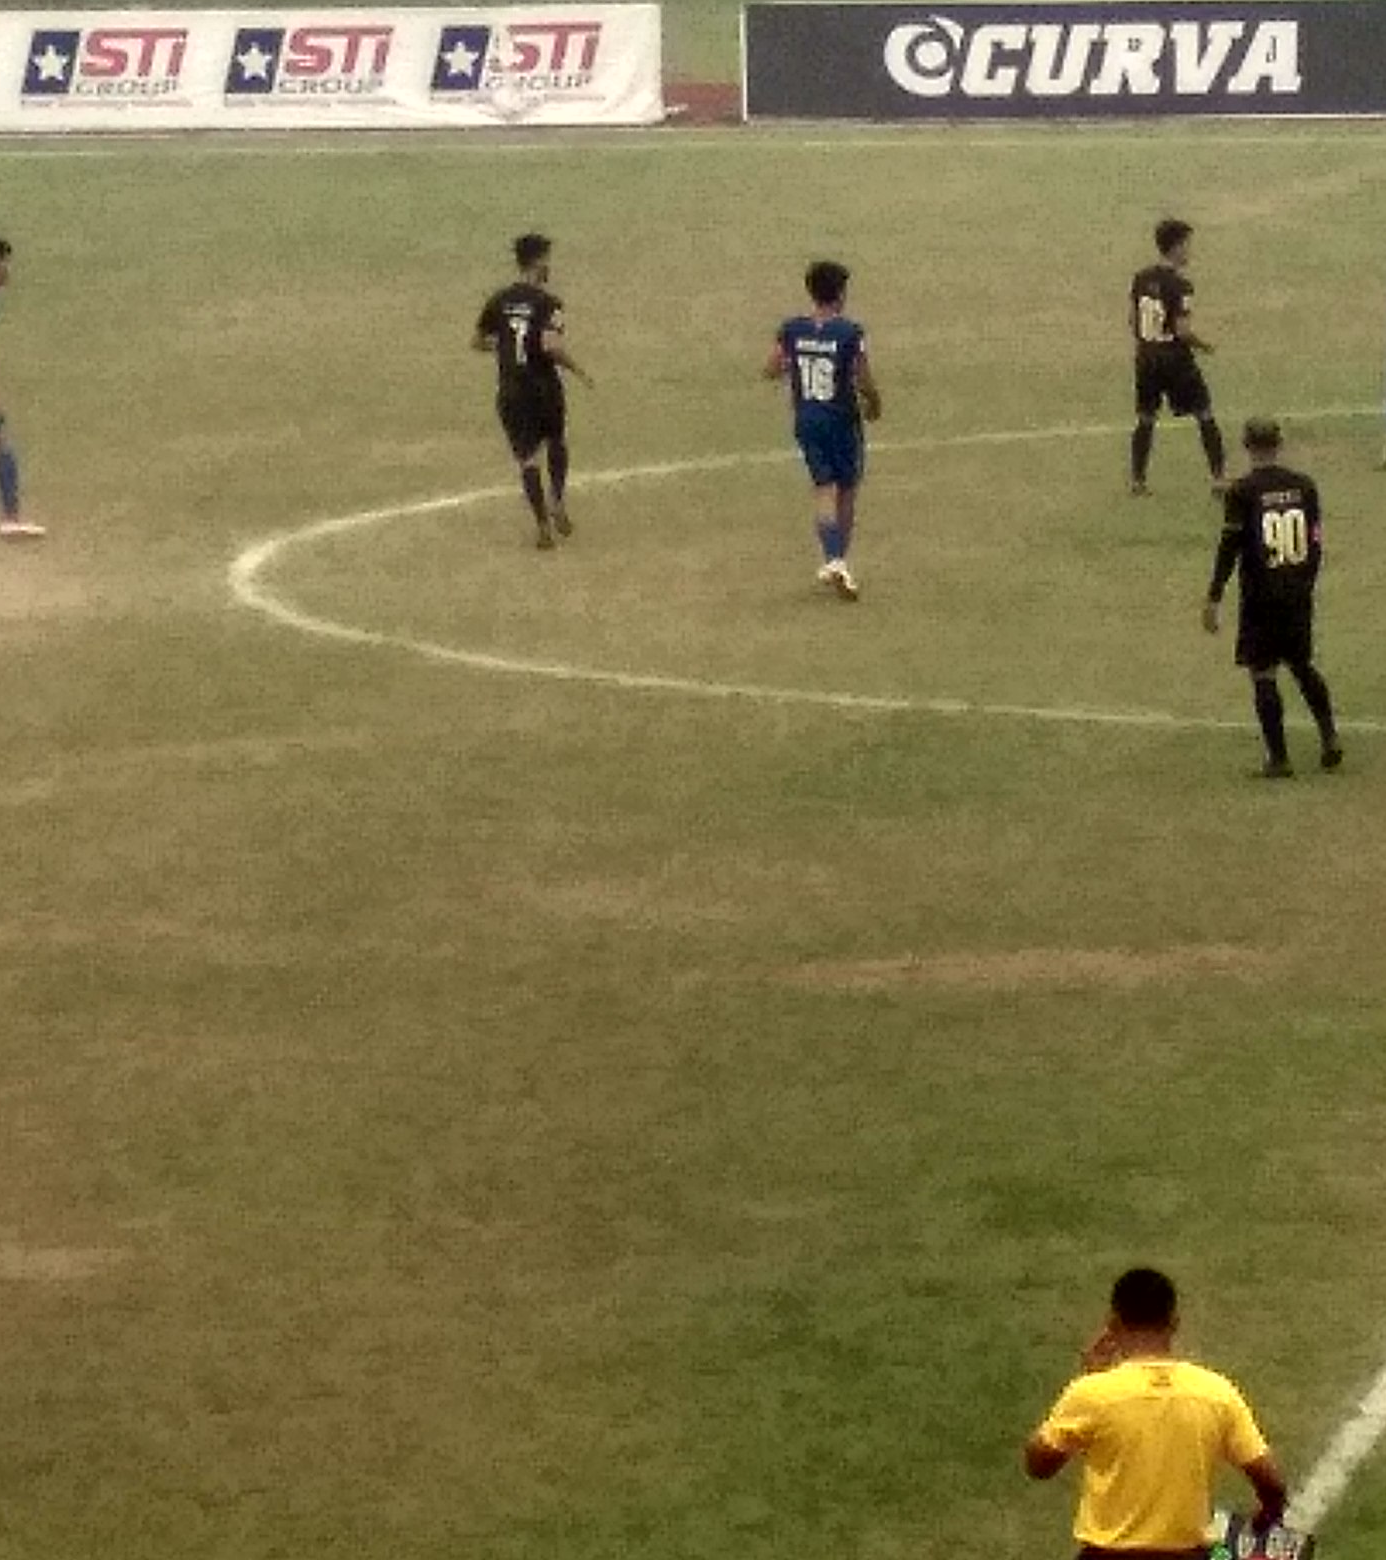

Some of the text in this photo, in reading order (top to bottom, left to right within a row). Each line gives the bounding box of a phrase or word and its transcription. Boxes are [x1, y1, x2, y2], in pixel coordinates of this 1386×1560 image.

[79, 28, 188, 77] STI
[284, 26, 394, 77] STI
[489, 23, 602, 72] STI
[959, 19, 1303, 97] CURVA
[1262, 508, 1308, 570] 90
